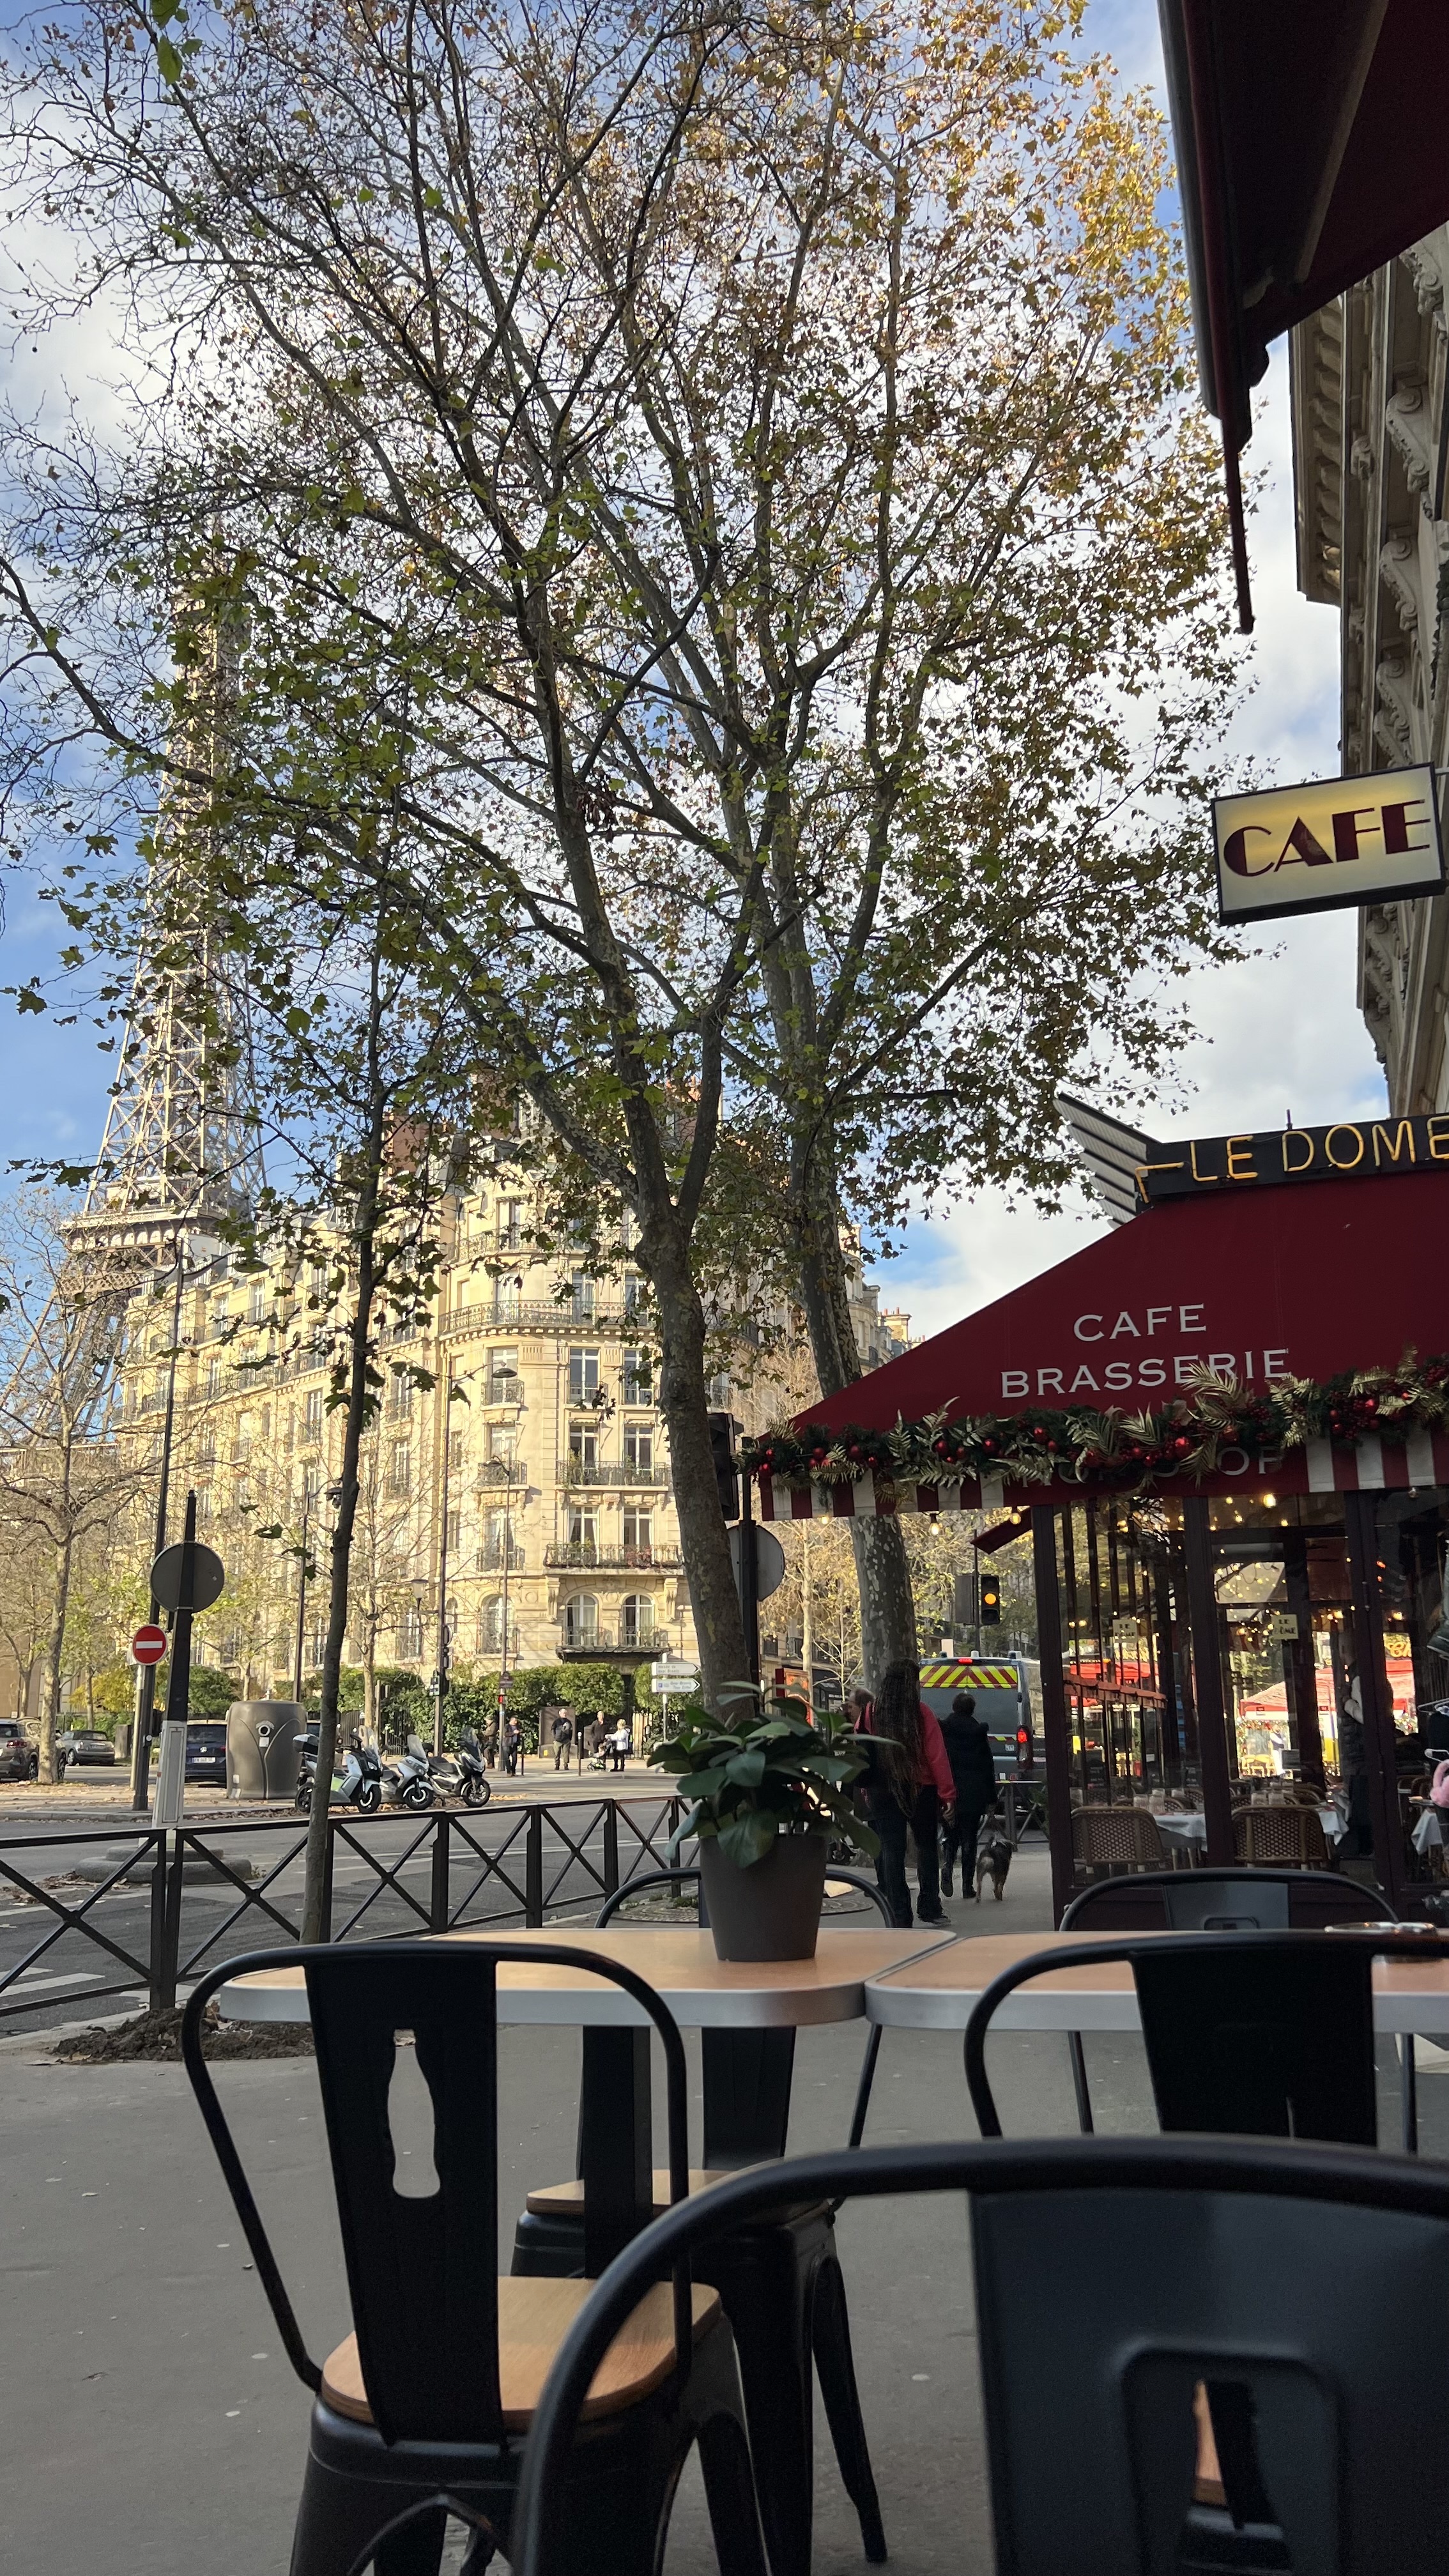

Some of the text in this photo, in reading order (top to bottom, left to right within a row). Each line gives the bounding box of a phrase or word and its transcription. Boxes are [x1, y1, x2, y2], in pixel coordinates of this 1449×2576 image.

[1223, 799, 1431, 877] CAFE
[1190, 1115, 1449, 1182] LE DOME
[1073, 1303, 1207, 1342] CAFE
[1000, 1347, 1292, 1398] BRASSERIE
